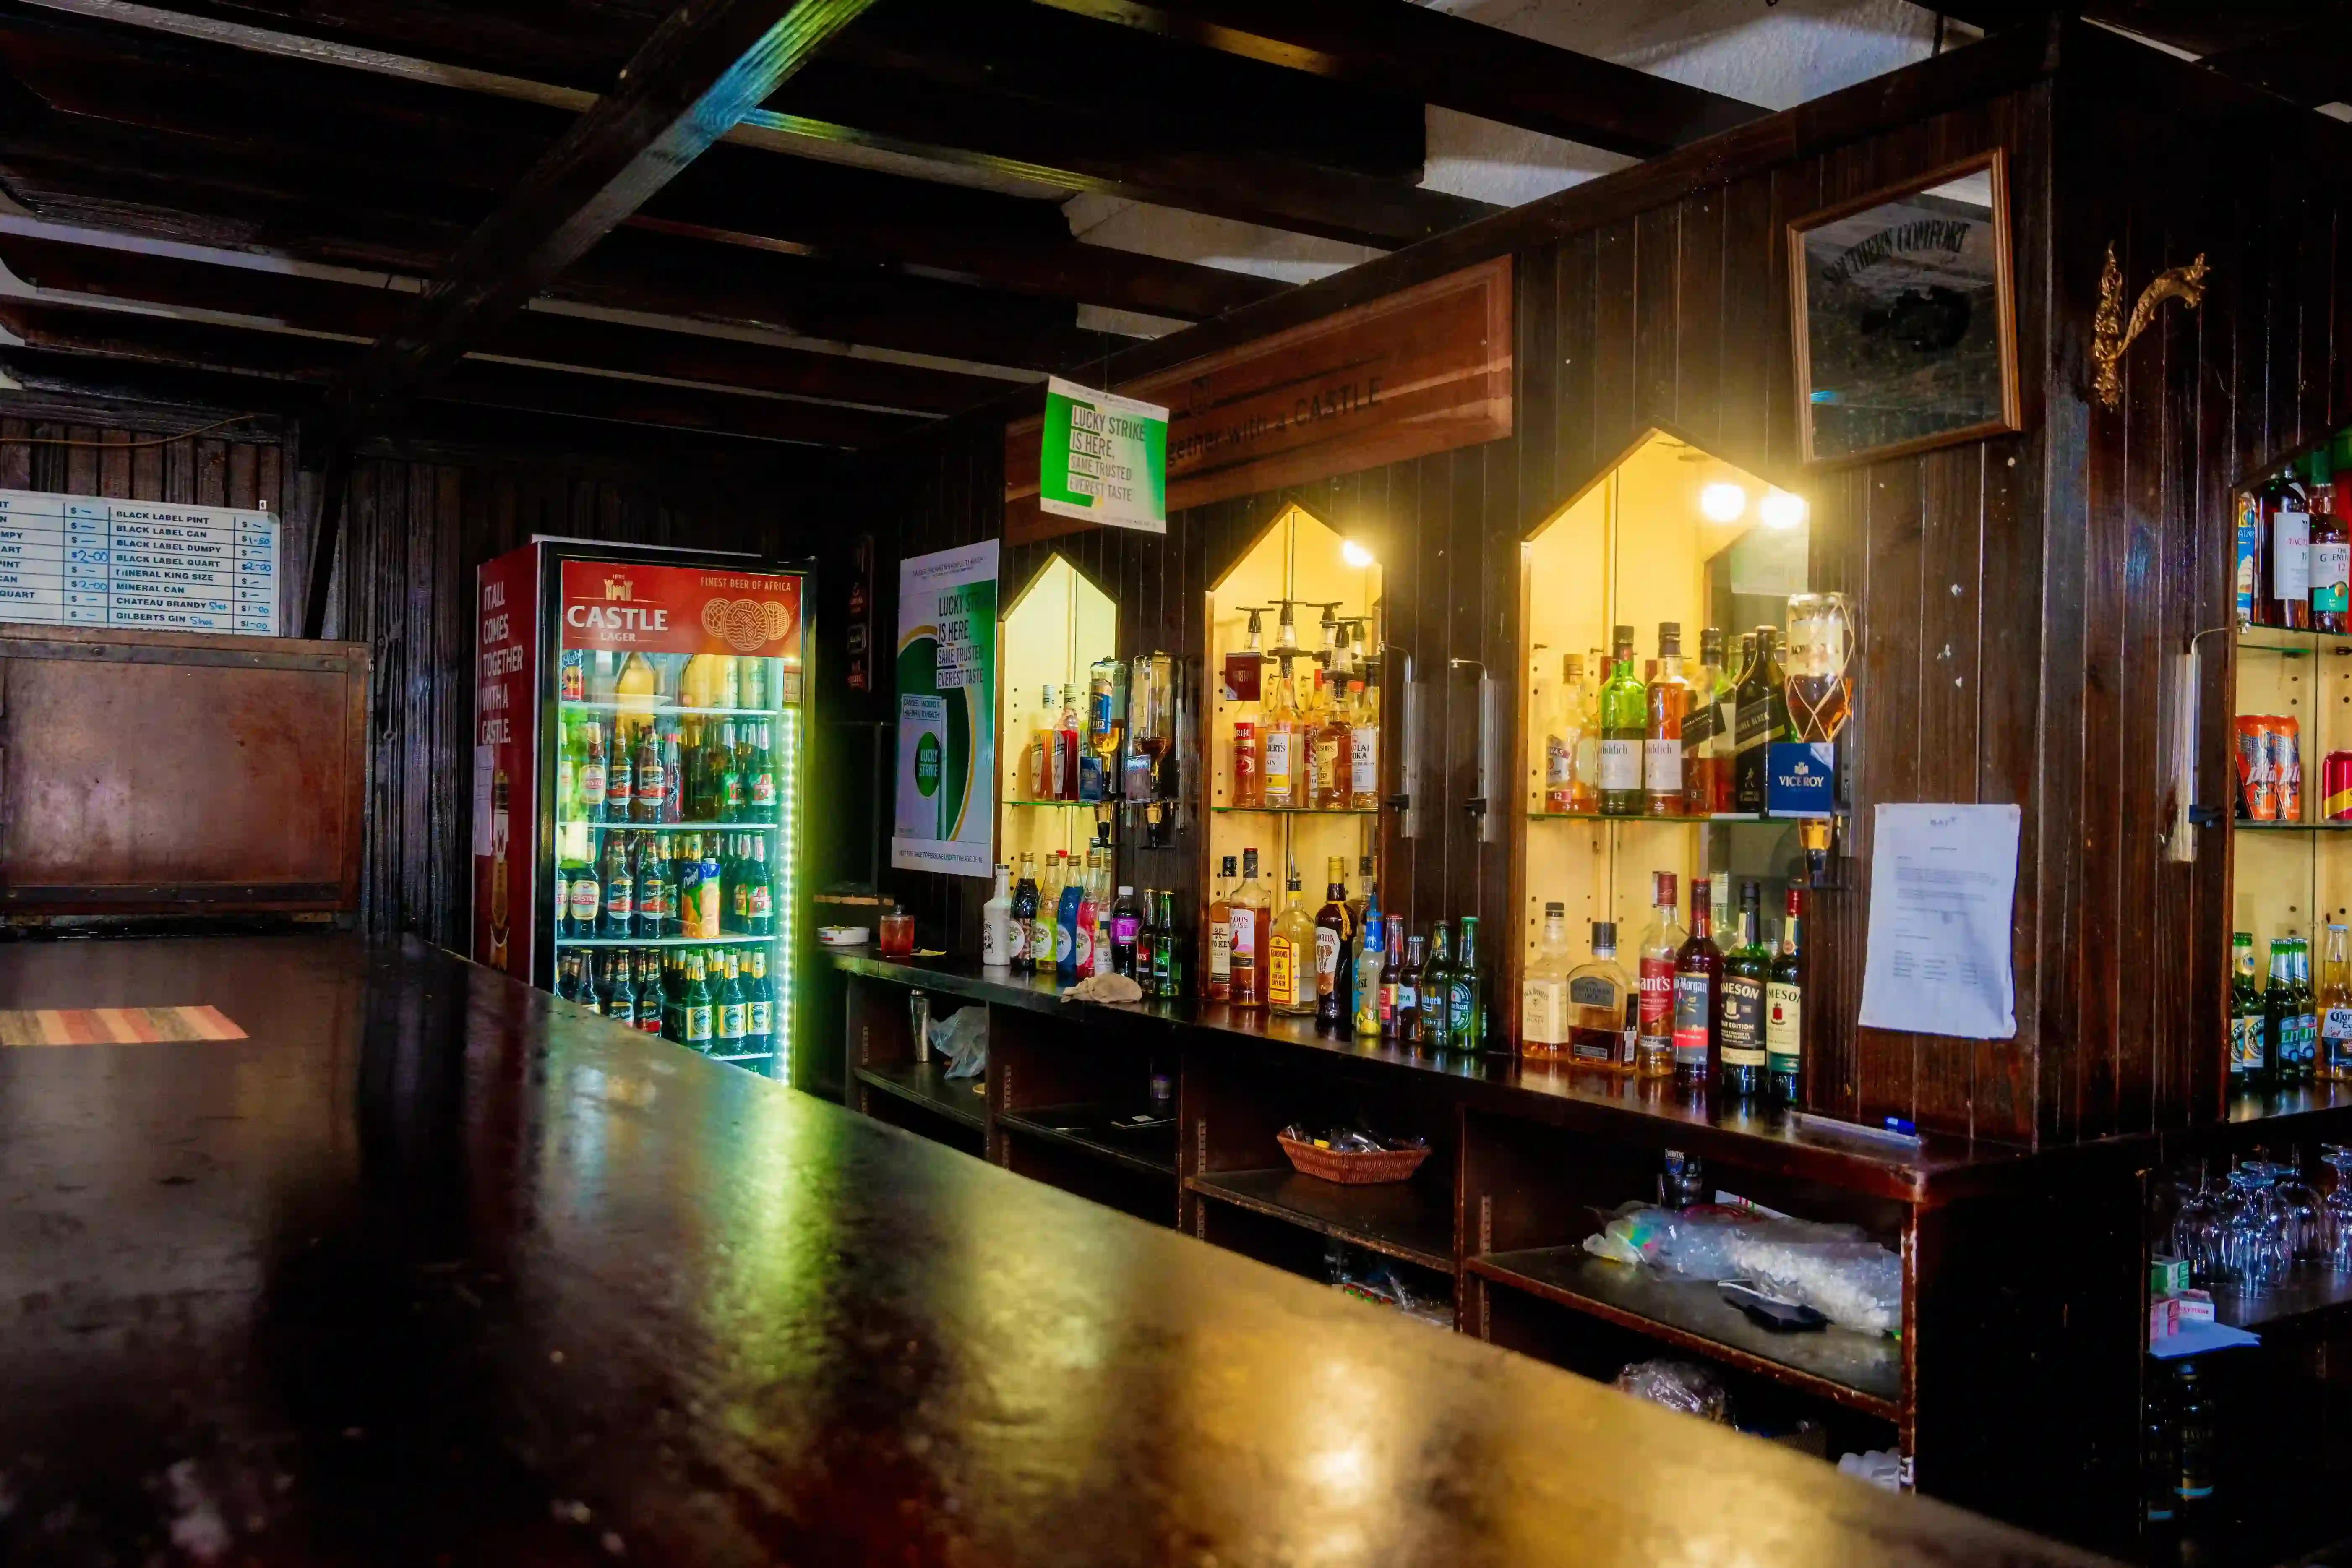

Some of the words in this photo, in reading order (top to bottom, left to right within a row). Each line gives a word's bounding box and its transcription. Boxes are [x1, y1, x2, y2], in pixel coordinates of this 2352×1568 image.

[1074, 406, 1106, 432] LUCKY
[1108, 417, 1146, 442] STRIKE
[1168, 428, 1222, 466] gether
[1228, 413, 1267, 444] with
[1275, 412, 1286, 432] a
[1294, 377, 1382, 427] CASTLE
[1072, 431, 1082, 450] IS
[1071, 456, 1093, 473] SAME
[1095, 461, 1132, 481] TRUSTED
[1070, 478, 1105, 497] EVEREST
[1108, 484, 1132, 502] TASTE
[116, 511, 149, 519] BLACK
[153, 513, 183, 522] LABEL
[187, 516, 210, 524] PINT
[153, 528, 183, 536] LABEL
[187, 530, 207, 538] CAN
[116, 539, 149, 548] BLACK
[153, 542, 184, 551] LABEL
[187, 544, 221, 553] DUMPY
[116, 554, 149, 563] BLACK
[153, 556, 184, 565] LABEL
[187, 559, 221, 568] QUART
[2320, 553, 2349, 562] GENLI
[2338, 563, 2346, 572] 12
[164, 571, 189, 580] KING
[116, 583, 161, 592] MINERAL
[701, 577, 727, 588] FINEST
[730, 579, 749, 589] BEER
[752, 581, 761, 590] OF
[764, 581, 791, 592] AFRICA
[0, 590, 35, 599] QUART
[484, 586, 492, 612] IT
[491, 581, 505, 607] ALL
[116, 597, 163, 607] CHATEAU
[167, 600, 206, 609] BRANDY
[939, 594, 963, 617] LUCKY
[116, 612, 165, 621] GILBERTS
[567, 605, 668, 630] CASTLE
[483, 613, 508, 644] COMES
[939, 623, 946, 643] IS
[600, 632, 636, 642] LAGER
[483, 645, 523, 678] TOGETHER
[938, 648, 954, 664] SAME
[957, 645, 983, 662] TRUSTED
[938, 670, 964, 687] EVEREST
[965, 668, 984, 684] TASTE
[483, 684, 501, 711] WITH
[503, 683, 508, 708] A
[1266, 743, 1286, 753] BERT'S
[920, 749, 938, 763] LUCKY
[919, 763, 938, 777] STRIKE
[1779, 776, 1824, 788] VICEROY
[1640, 976, 1670, 991] ant's
[1680, 977, 1707, 993] Morgan
[2330, 1011, 2352, 1024] Cor
[1729, 1021, 1755, 1031] EDITION
